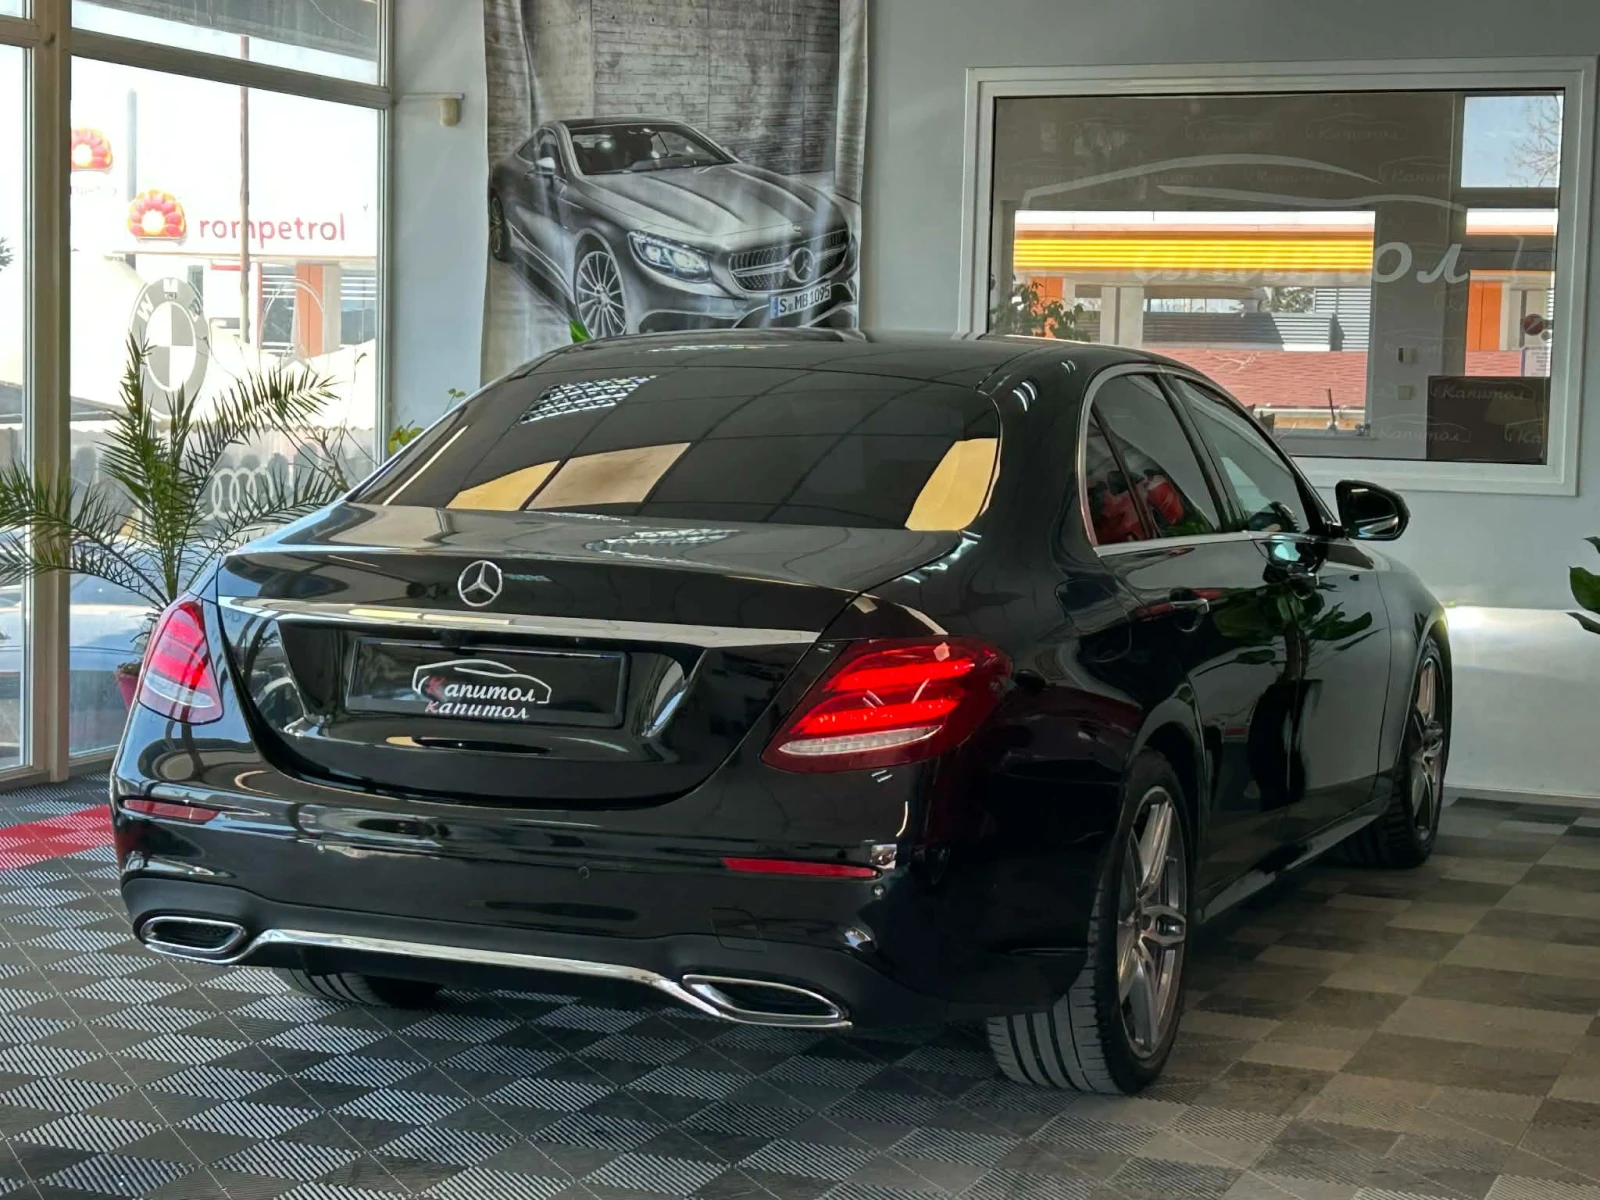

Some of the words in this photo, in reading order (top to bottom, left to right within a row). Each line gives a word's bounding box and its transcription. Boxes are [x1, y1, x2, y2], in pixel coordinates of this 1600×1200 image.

[199, 212, 346, 248] rompetrol
[779, 298, 787, 313] S
[809, 284, 830, 304] 1095
[425, 674, 536, 703] Капитол
